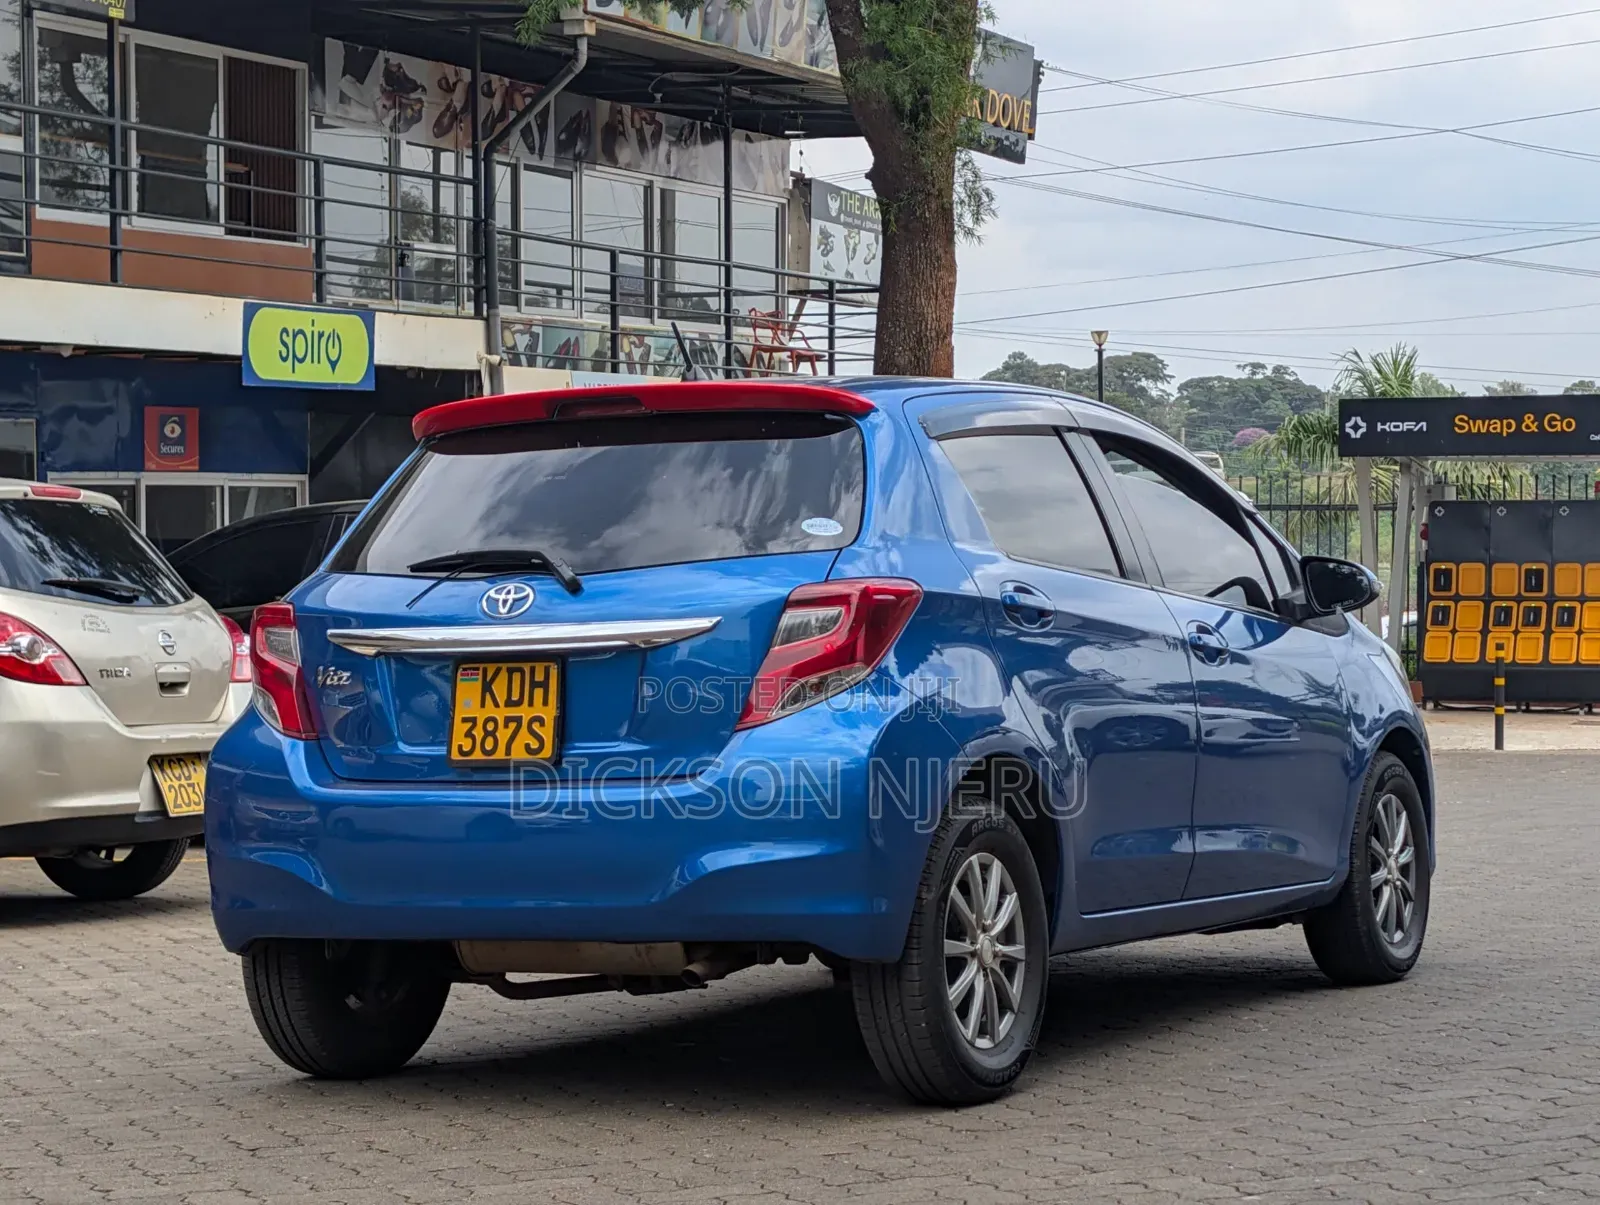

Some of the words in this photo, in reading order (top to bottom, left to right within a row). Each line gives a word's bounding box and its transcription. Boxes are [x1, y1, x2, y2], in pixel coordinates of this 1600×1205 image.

[987, 88, 1035, 134] DOVE
[841, 191, 860, 214] THE
[278, 318, 343, 375] spiro
[1377, 421, 1427, 432] KOFA
[1453, 413, 1516, 436] Swap
[1521, 413, 1539, 432] &
[1543, 413, 1576, 433] Go
[160, 442, 184, 454] Securex
[480, 665, 551, 709] KDH
[457, 715, 546, 757] 387S
